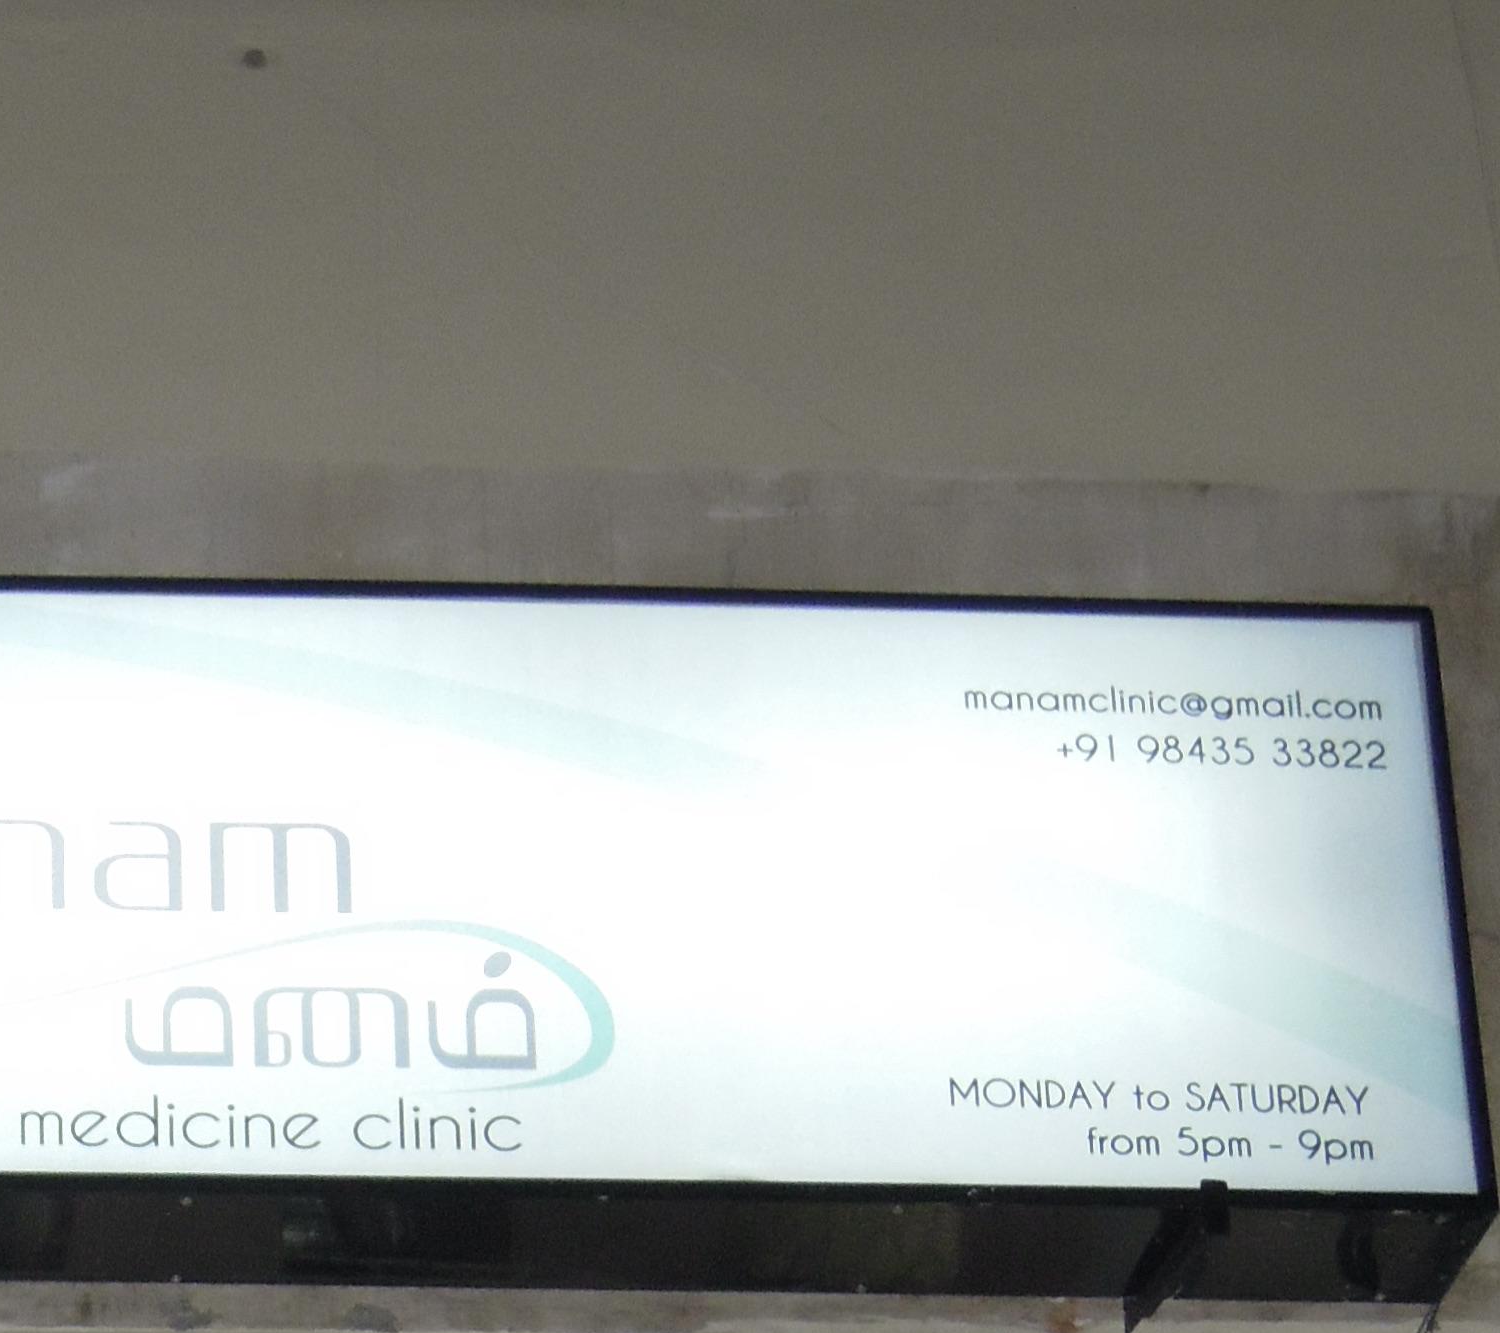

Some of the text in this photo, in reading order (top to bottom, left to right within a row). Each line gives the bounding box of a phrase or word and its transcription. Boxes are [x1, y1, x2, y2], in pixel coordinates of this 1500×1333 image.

[964, 686, 1383, 721] manamclinic@gmail.com
[1057, 734, 1387, 769] +91 98435 33822
[950, 1078, 1370, 1116] MONDAY to SATURDAY
[21, 1096, 321, 1150] medicine
[353, 1099, 523, 1153] clinic
[1088, 1127, 1160, 1157] from
[1177, 1127, 1252, 1161] 5pm
[1298, 1129, 1374, 1164] 9pm
